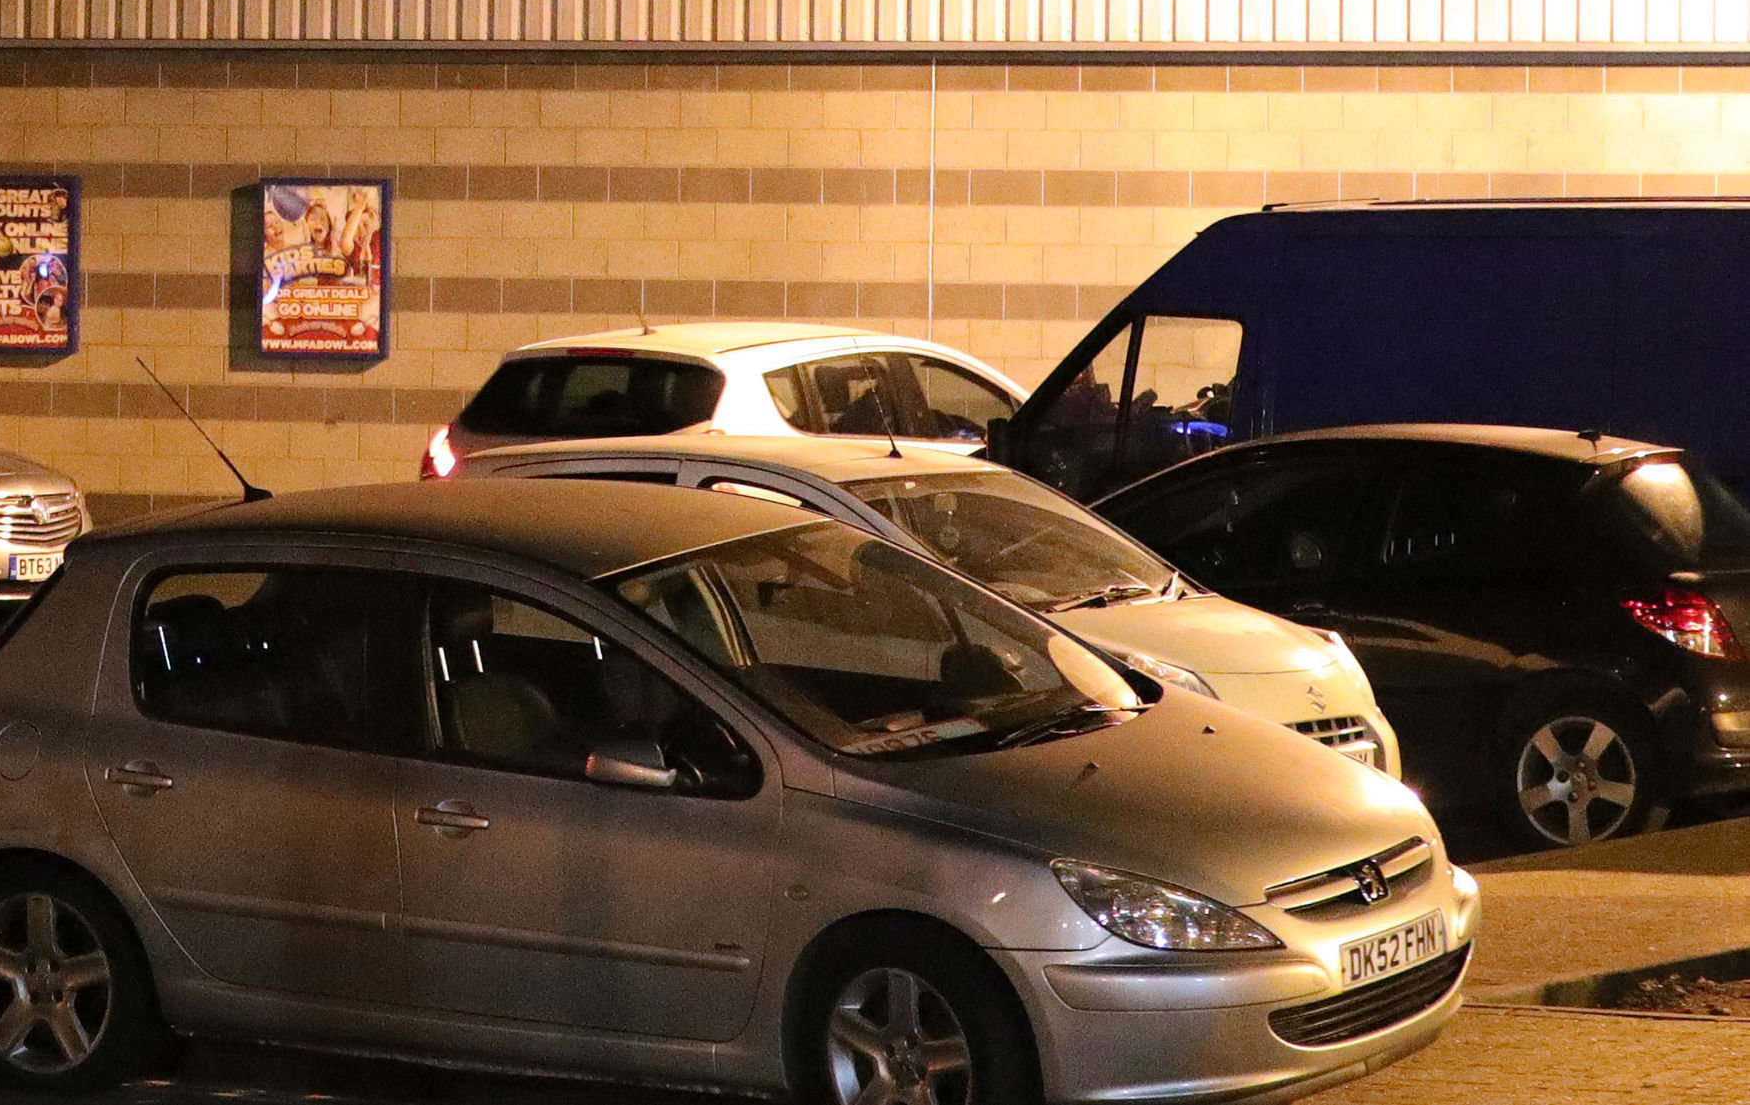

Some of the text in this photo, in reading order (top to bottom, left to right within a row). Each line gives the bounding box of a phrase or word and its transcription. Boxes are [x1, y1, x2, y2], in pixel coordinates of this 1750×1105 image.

[4, 222, 68, 236] ONLINE
[293, 288, 330, 298] GREAT
[332, 288, 369, 298] DEALS
[278, 303, 358, 316] GO ONLINE
[19, 558, 52, 576] BT63
[1349, 915, 1437, 982] DK52 FHN
